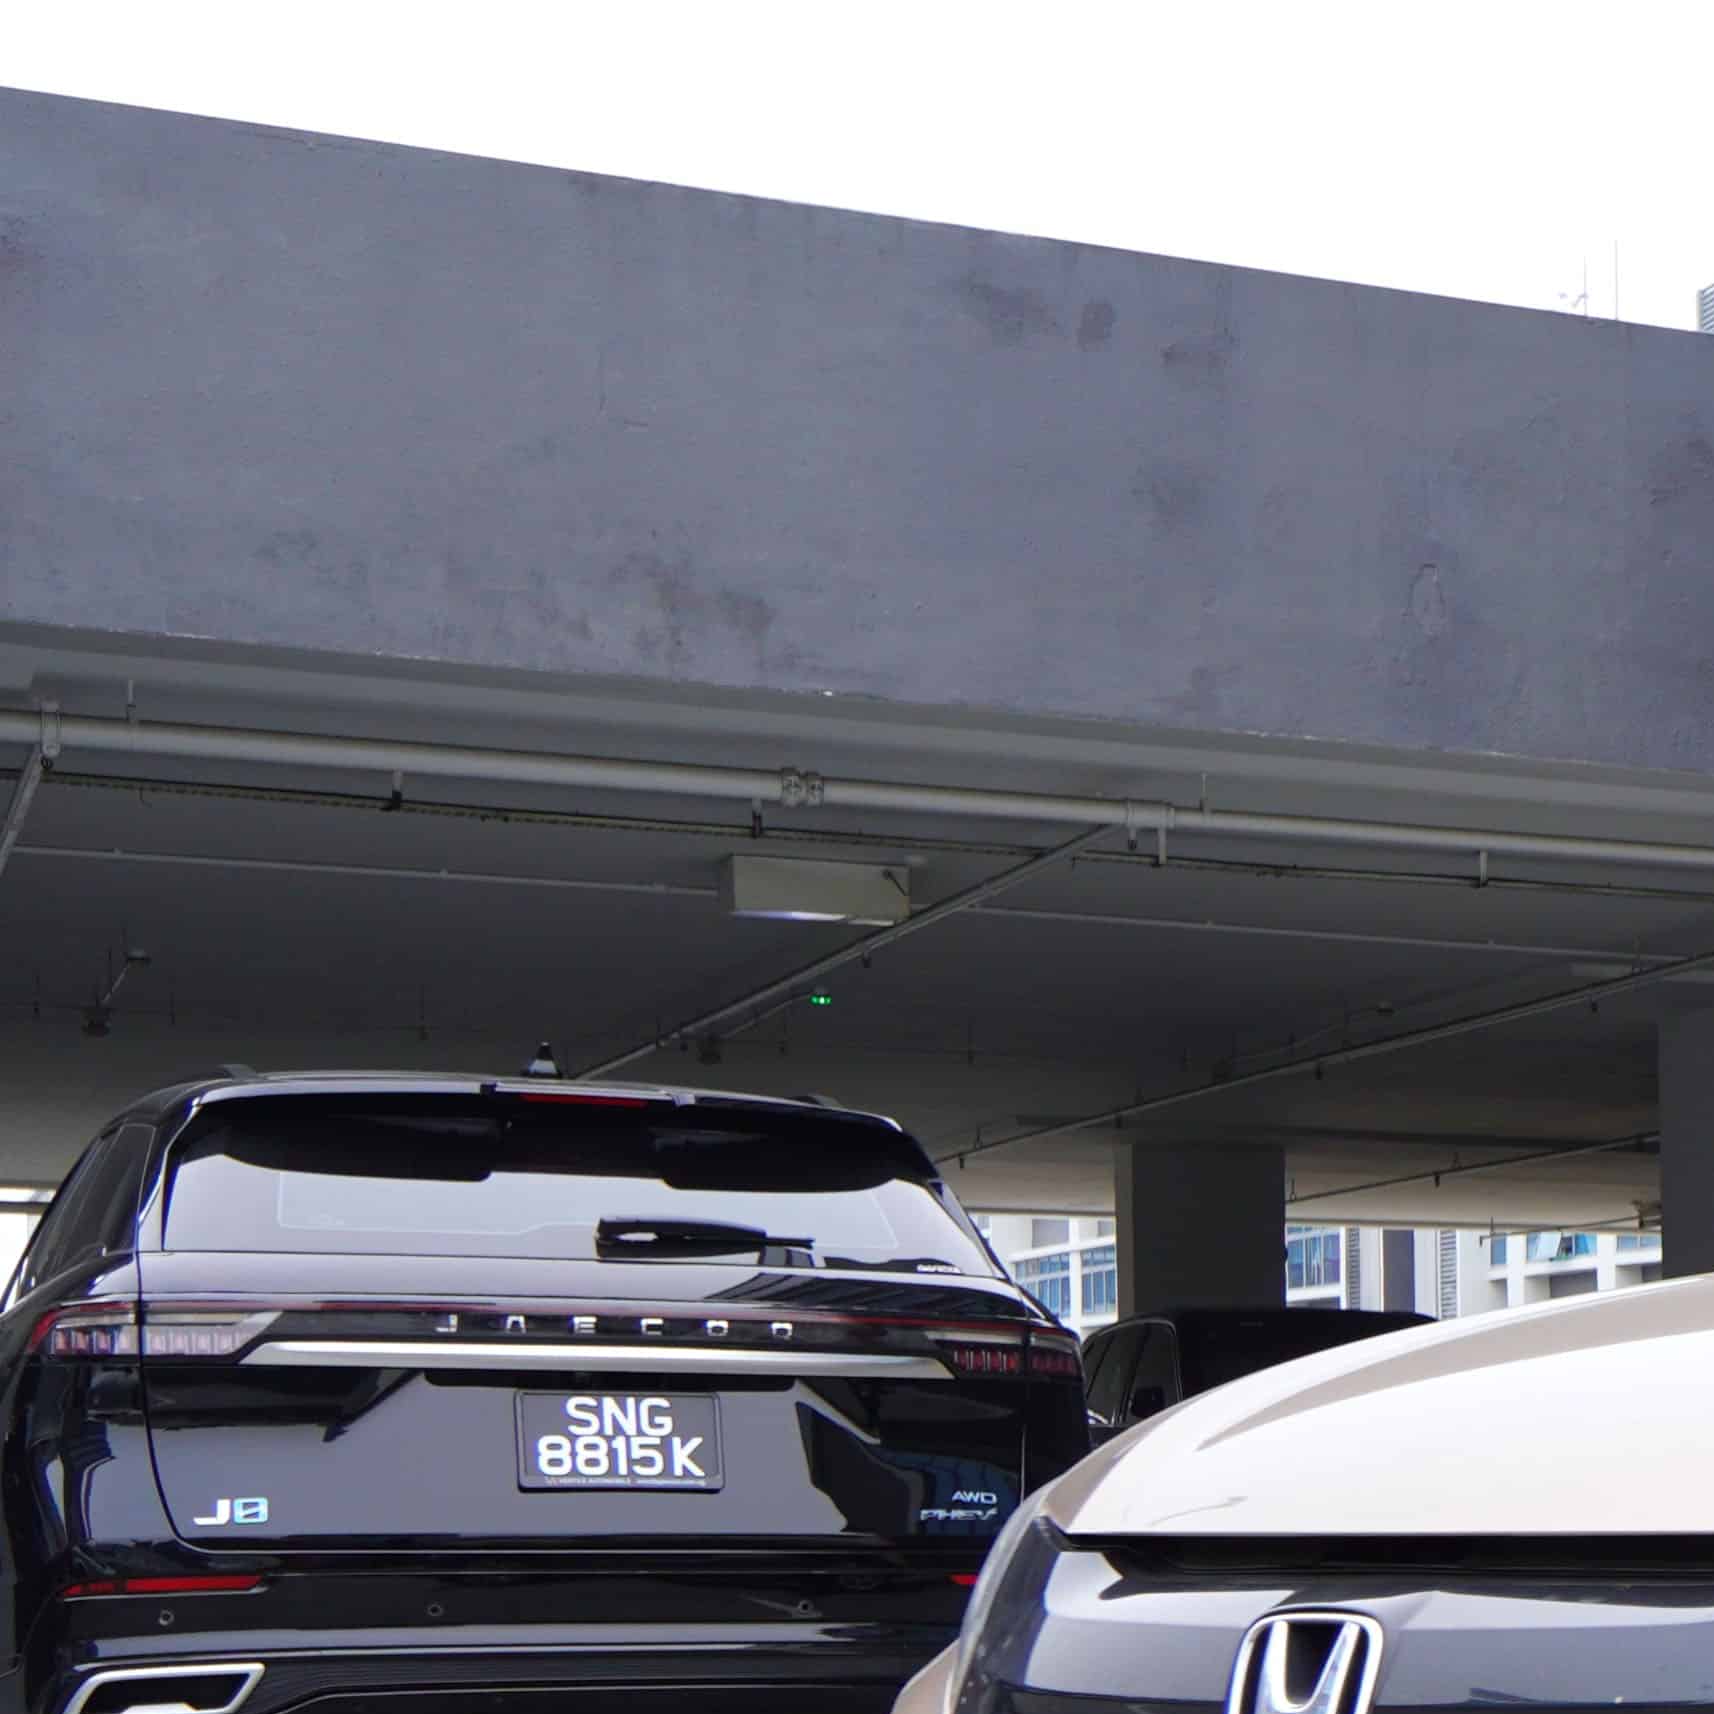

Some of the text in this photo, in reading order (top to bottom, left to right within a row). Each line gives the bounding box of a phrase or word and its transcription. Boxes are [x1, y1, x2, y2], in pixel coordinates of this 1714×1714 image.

[566, 1396, 673, 1436] SNG
[537, 1435, 705, 1476] 8815K
[193, 1497, 268, 1526] J8
[951, 1491, 998, 1504] AWD
